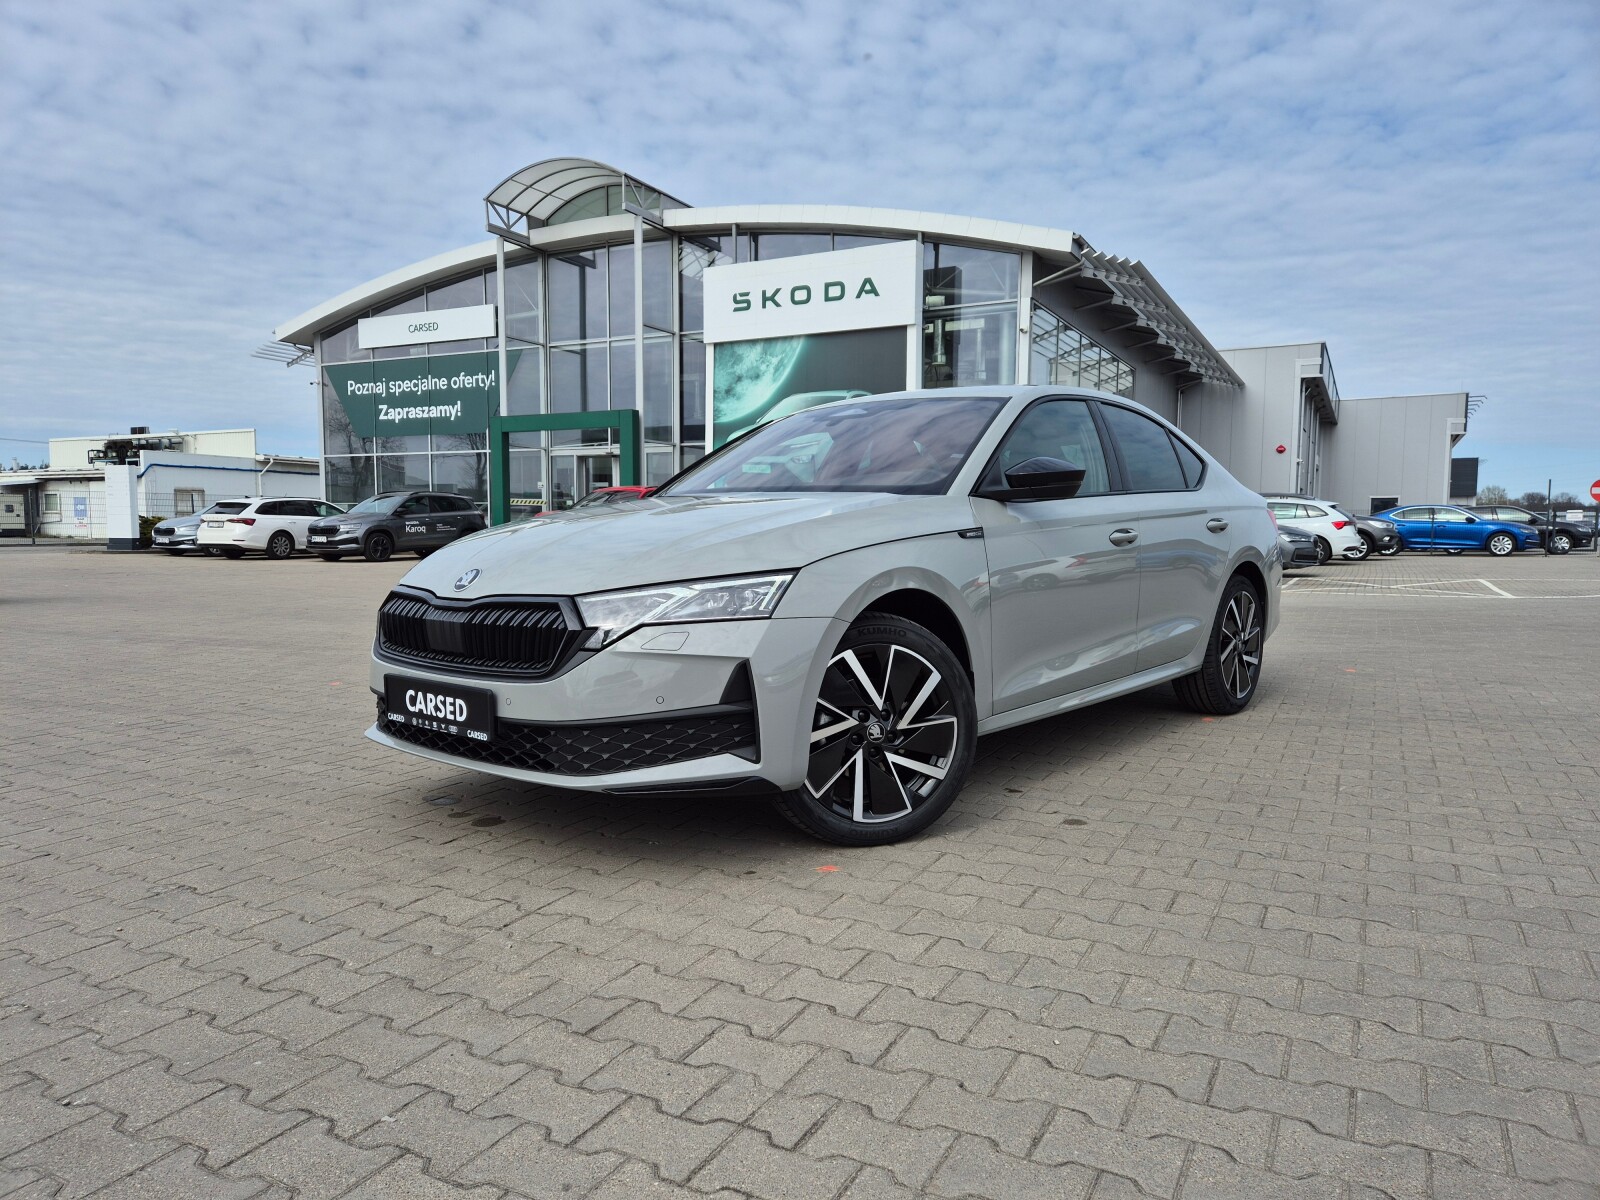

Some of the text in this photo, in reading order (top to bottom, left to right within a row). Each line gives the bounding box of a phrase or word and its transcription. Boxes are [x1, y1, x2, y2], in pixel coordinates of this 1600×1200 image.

[408, 321, 439, 334] CARSED
[347, 370, 496, 397] Poznaj specjalne oferty!
[378, 401, 462, 423] Zapraszamy!
[405, 525, 426, 534] Karoq
[857, 626, 907, 637] KUMHO
[405, 689, 468, 722] CARSED
[387, 712, 405, 723] CARSED
[466, 729, 488, 741] CARSED
